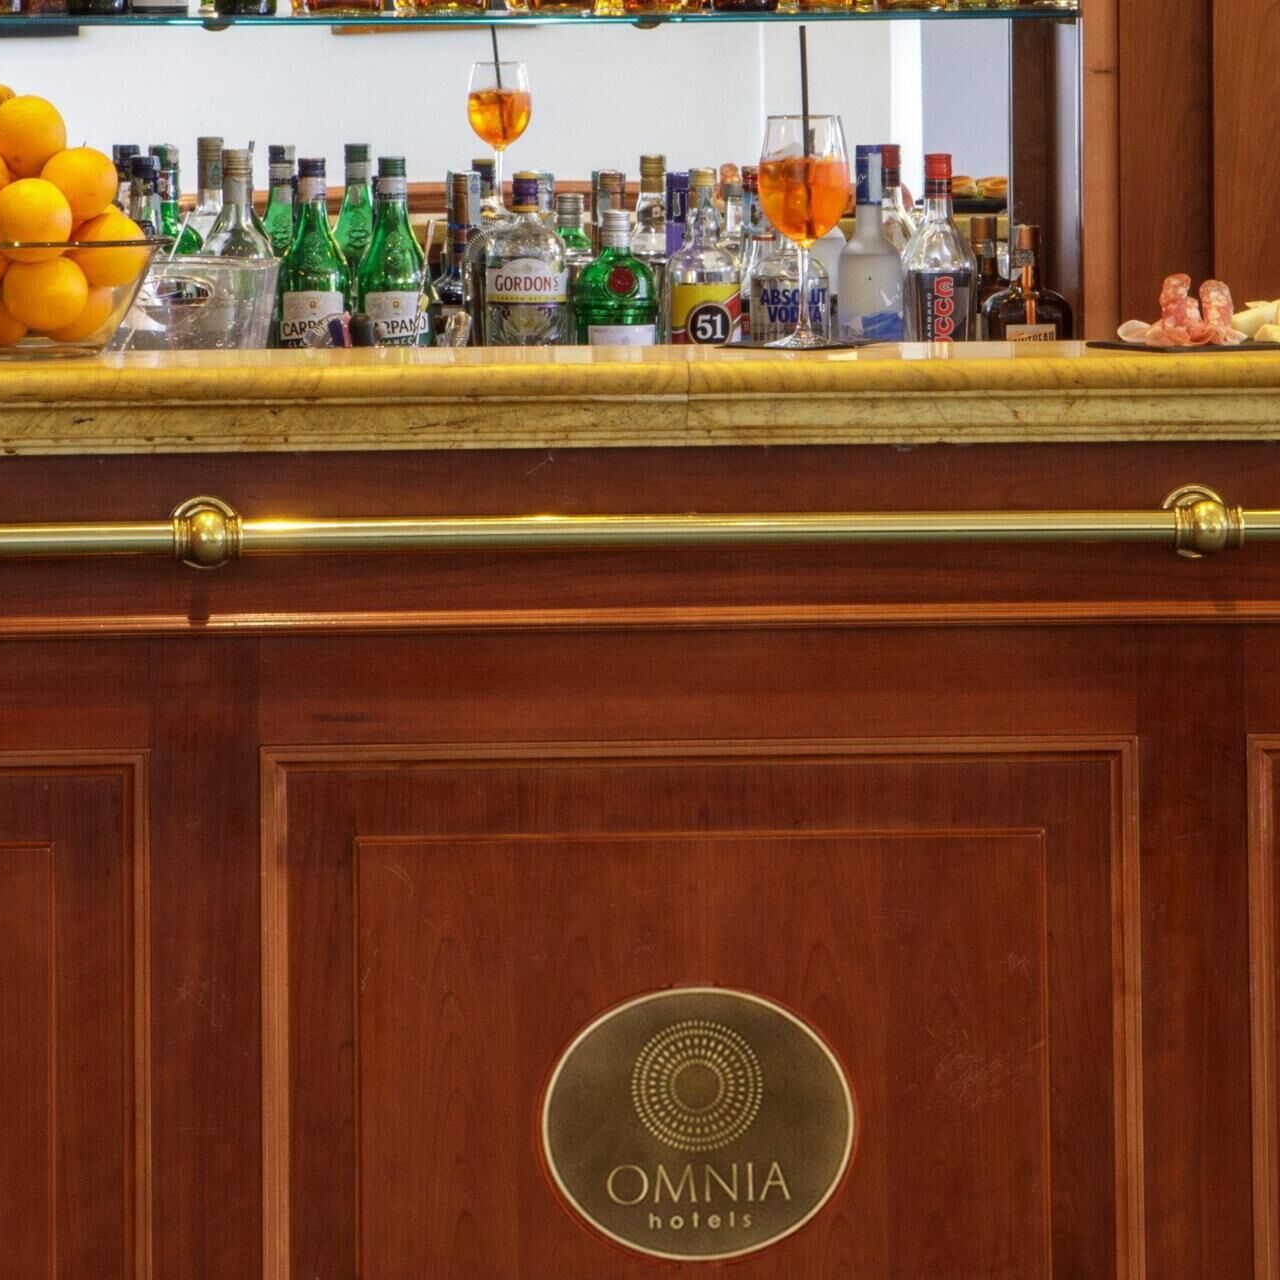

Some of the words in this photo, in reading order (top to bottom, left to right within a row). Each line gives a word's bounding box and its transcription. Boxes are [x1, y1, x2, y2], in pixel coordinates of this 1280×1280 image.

[760, 288, 827, 306] ABSOUT
[767, 306, 823, 324] VODA
[696, 314, 725, 340] 51
[607, 1161, 791, 1206] OMNIA
[649, 1211, 752, 1230] hotels
